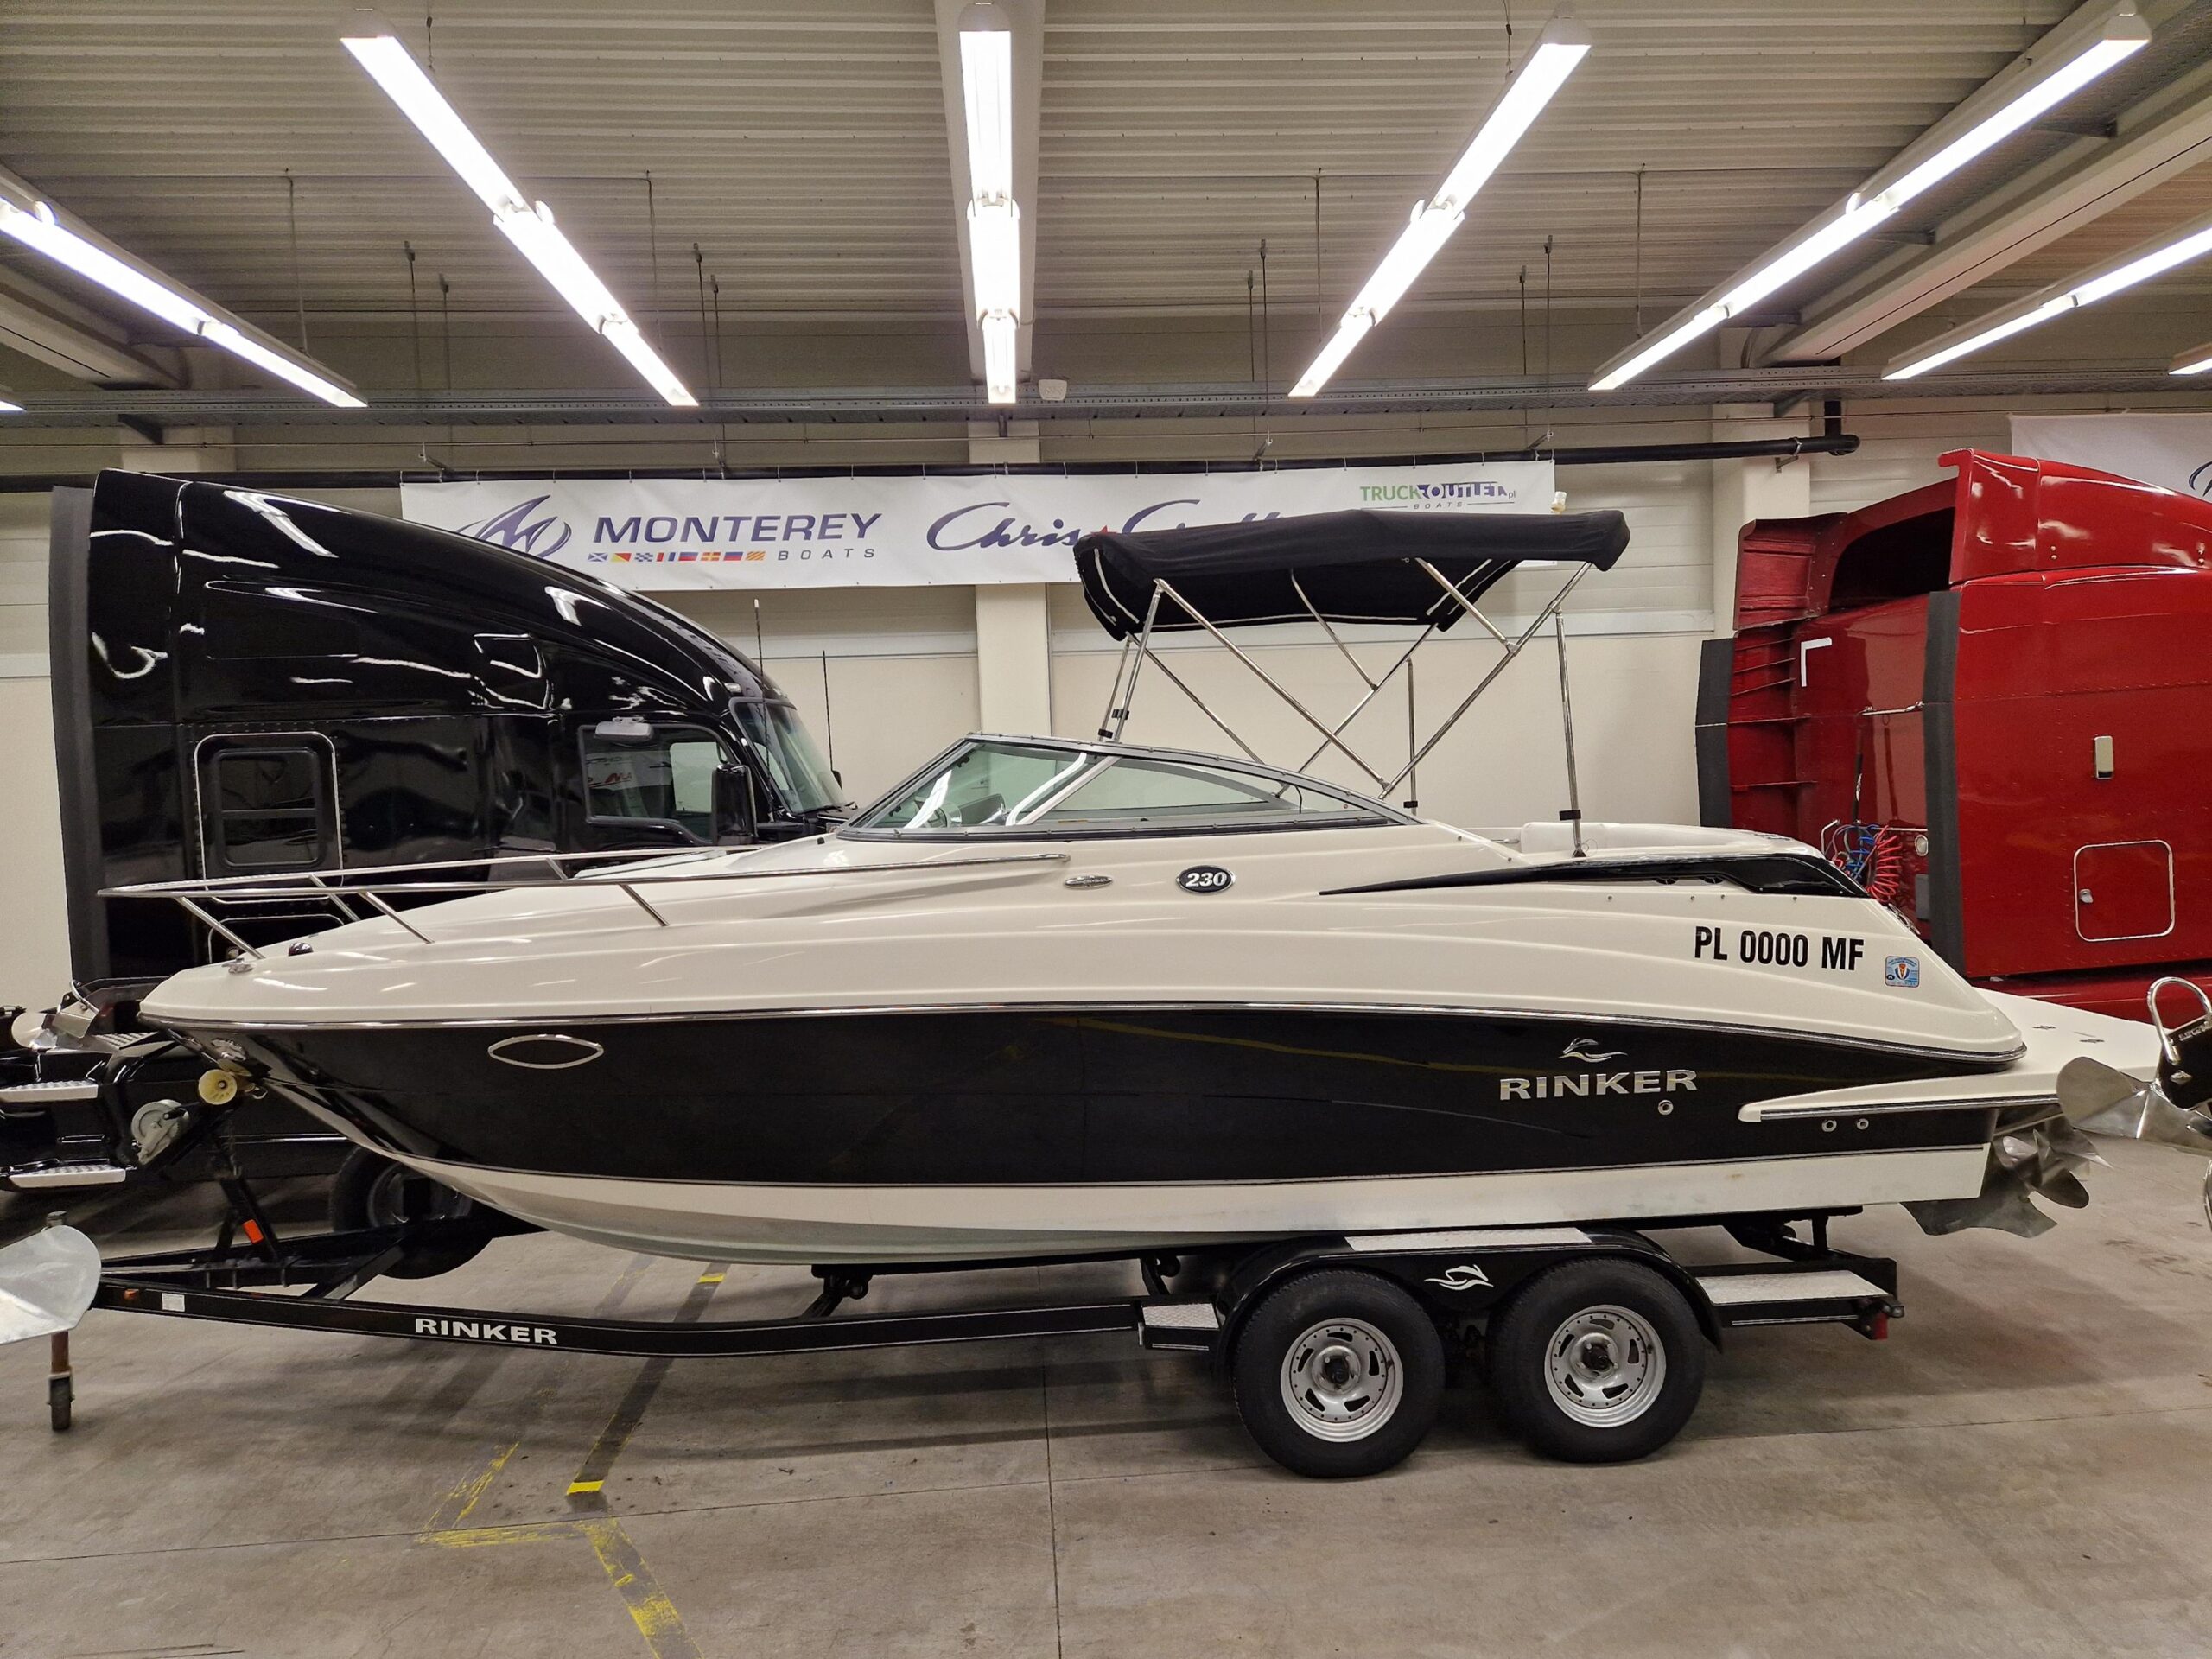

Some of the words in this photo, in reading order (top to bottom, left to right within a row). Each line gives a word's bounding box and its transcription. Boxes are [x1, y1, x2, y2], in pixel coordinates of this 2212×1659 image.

[1413, 501, 1463, 510] BOATS
[593, 513, 883, 543] MONTEREY
[926, 502, 1081, 551] Chris
[777, 548, 875, 561] BOATS
[1185, 872, 1228, 887] 230
[1694, 925, 1727, 961] PL
[1739, 930, 1808, 967] 0000
[1821, 936, 1865, 971] MF
[1499, 1069, 1698, 1101] RINKER
[415, 1318, 557, 1344] RINKER
